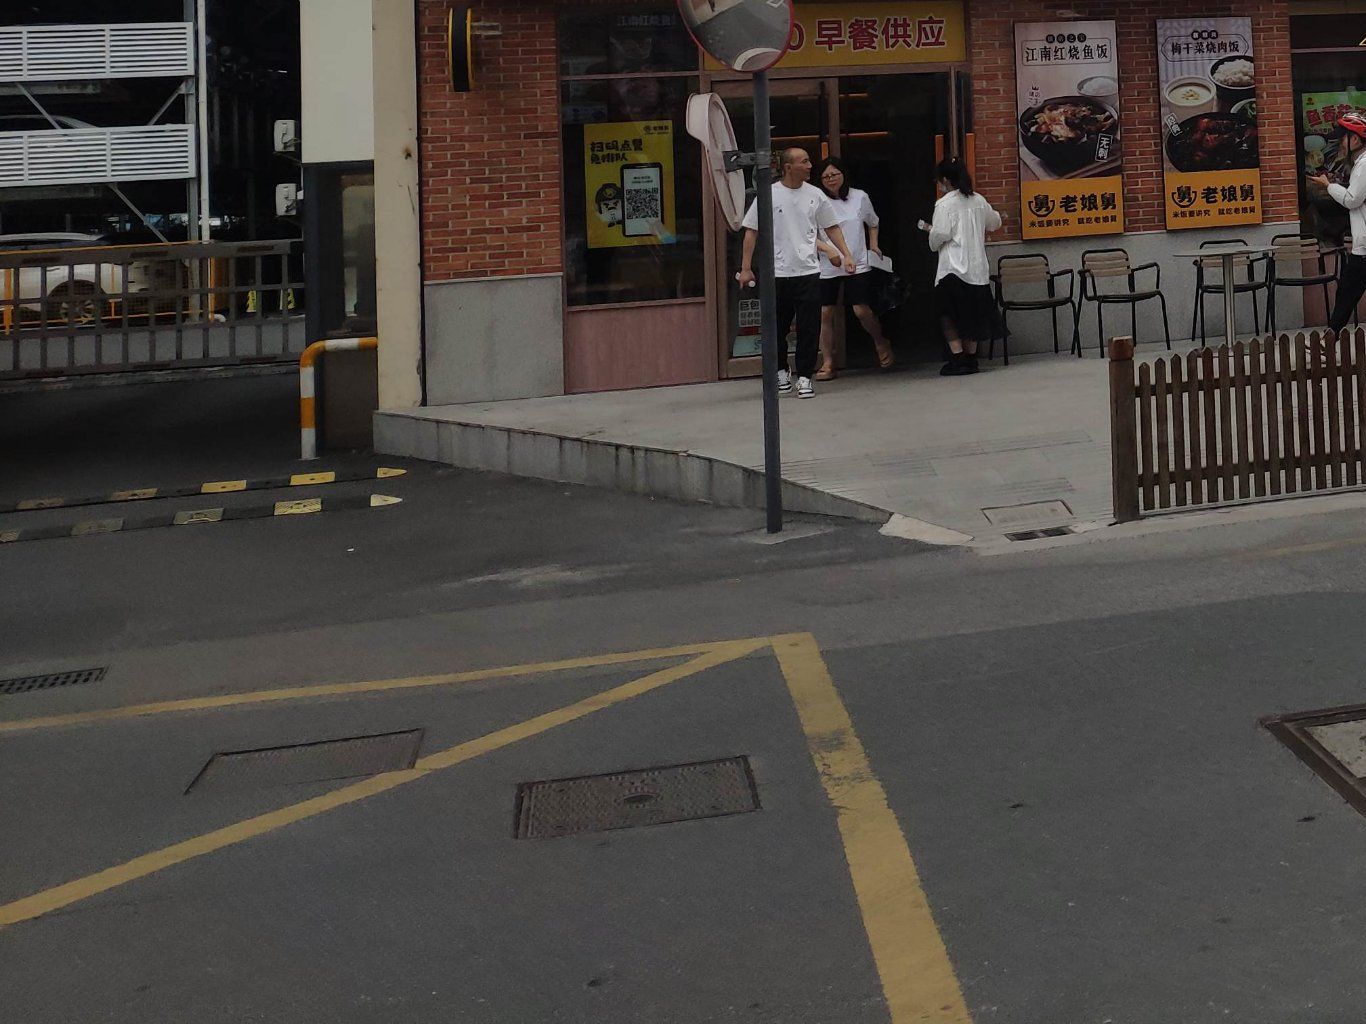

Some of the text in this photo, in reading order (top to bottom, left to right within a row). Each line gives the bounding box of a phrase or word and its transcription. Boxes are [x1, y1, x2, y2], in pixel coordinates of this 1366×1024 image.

[815, 15, 946, 52] 早餐供应
[1025, 44, 1108, 62] 江南红烧鱼饭
[1171, 40, 1239, 55] 梅干菜烧肉饭
[1059, 193, 1117, 213] 老娘舅
[1201, 184, 1255, 203] 老娘舅
